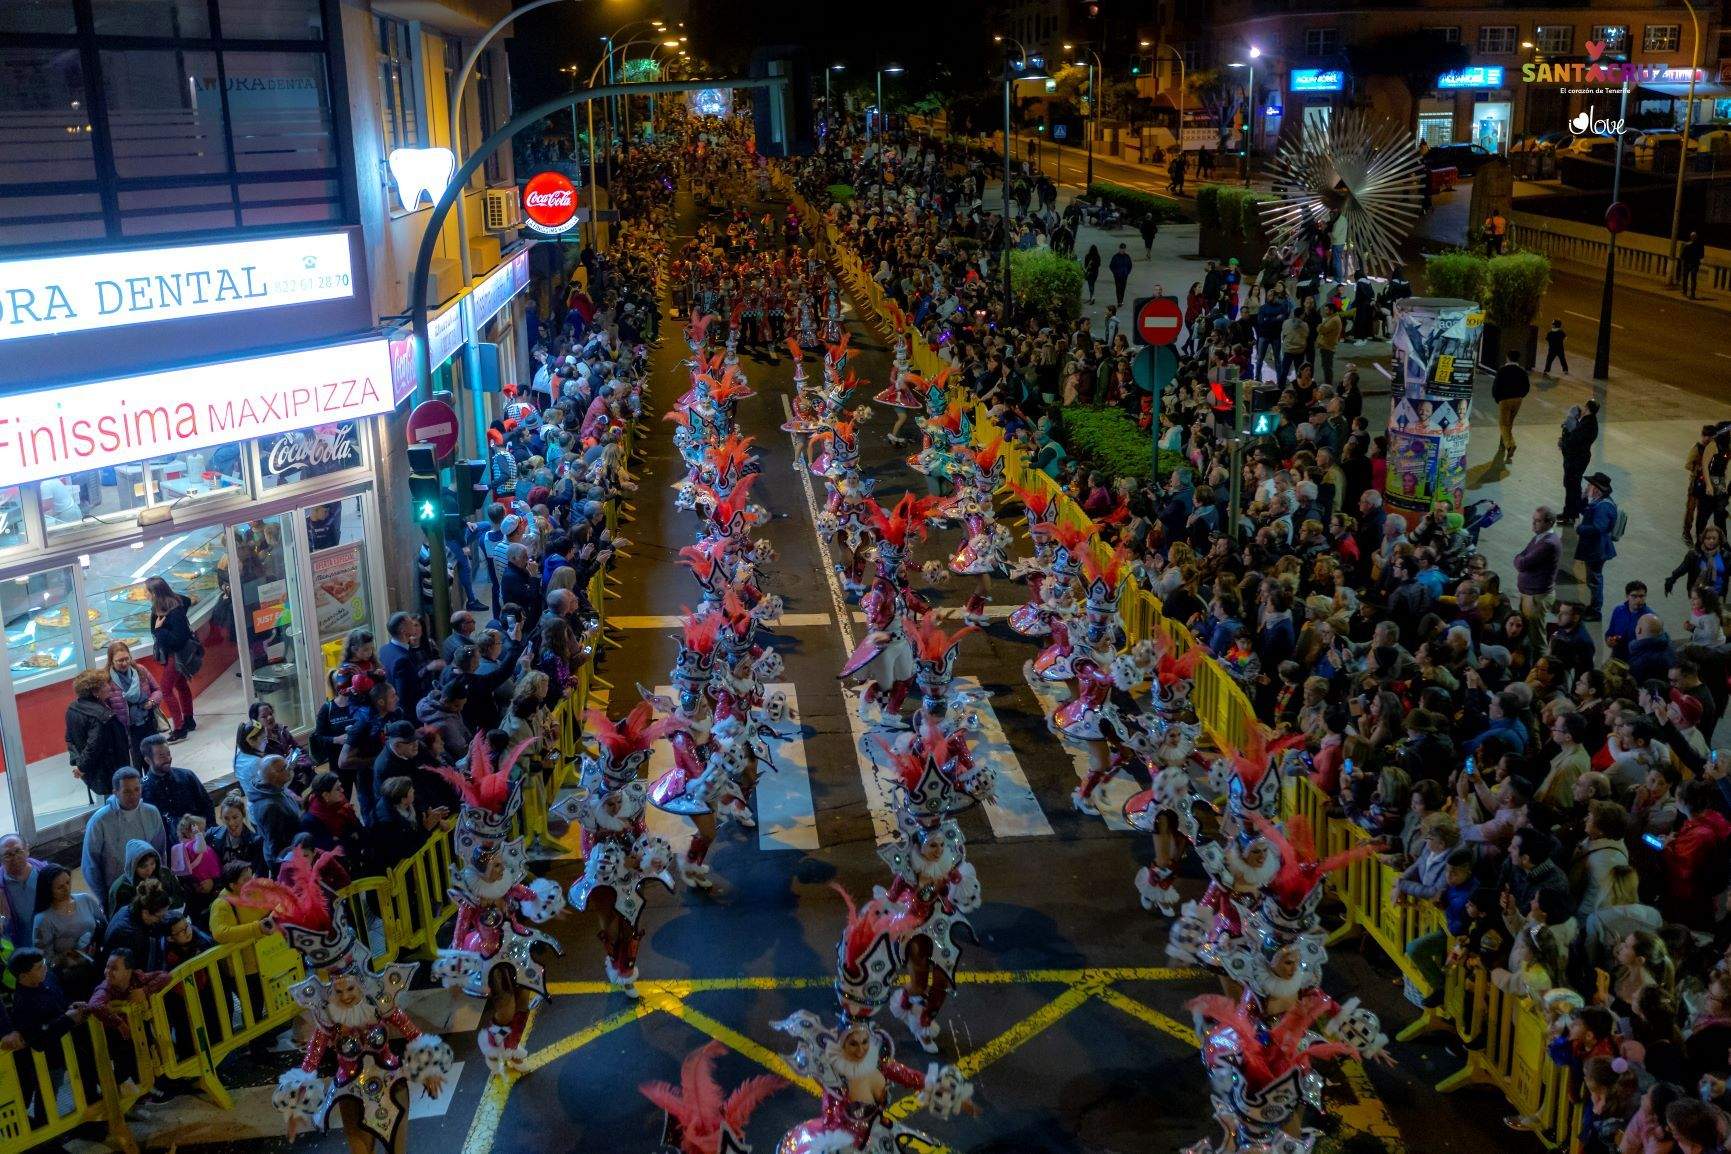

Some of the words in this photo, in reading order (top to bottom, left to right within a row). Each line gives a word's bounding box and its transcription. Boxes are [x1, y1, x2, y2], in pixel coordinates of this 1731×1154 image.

[0, 284, 78, 324] RA
[95, 266, 268, 315] DENTAL
[318, 276, 332, 289] 28
[335, 274, 349, 287] 70
[208, 377, 380, 433] MAXIPIZZA
[268, 423, 353, 474] Coca-Cola
[256, 613, 273, 626] JUST
